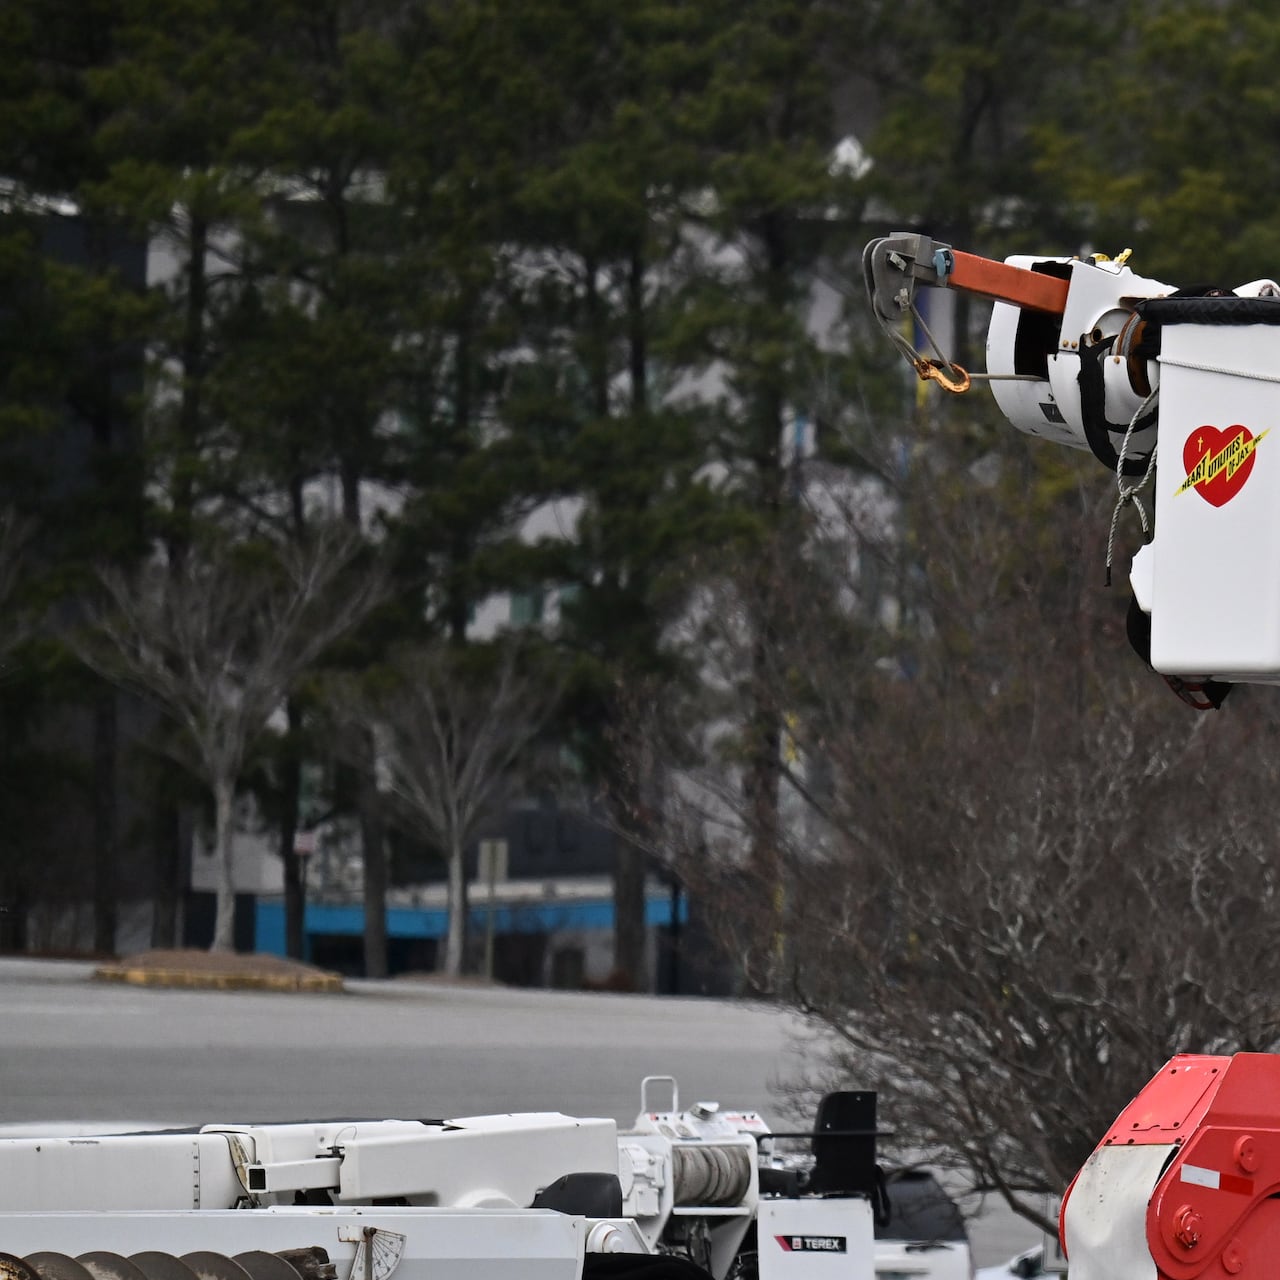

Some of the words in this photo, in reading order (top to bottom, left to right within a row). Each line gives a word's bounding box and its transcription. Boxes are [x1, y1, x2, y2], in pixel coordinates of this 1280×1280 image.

[1182, 456, 1208, 491] HEART
[1208, 436, 1241, 478] UTILITIES
[804, 1238, 840, 1250] TEREX
